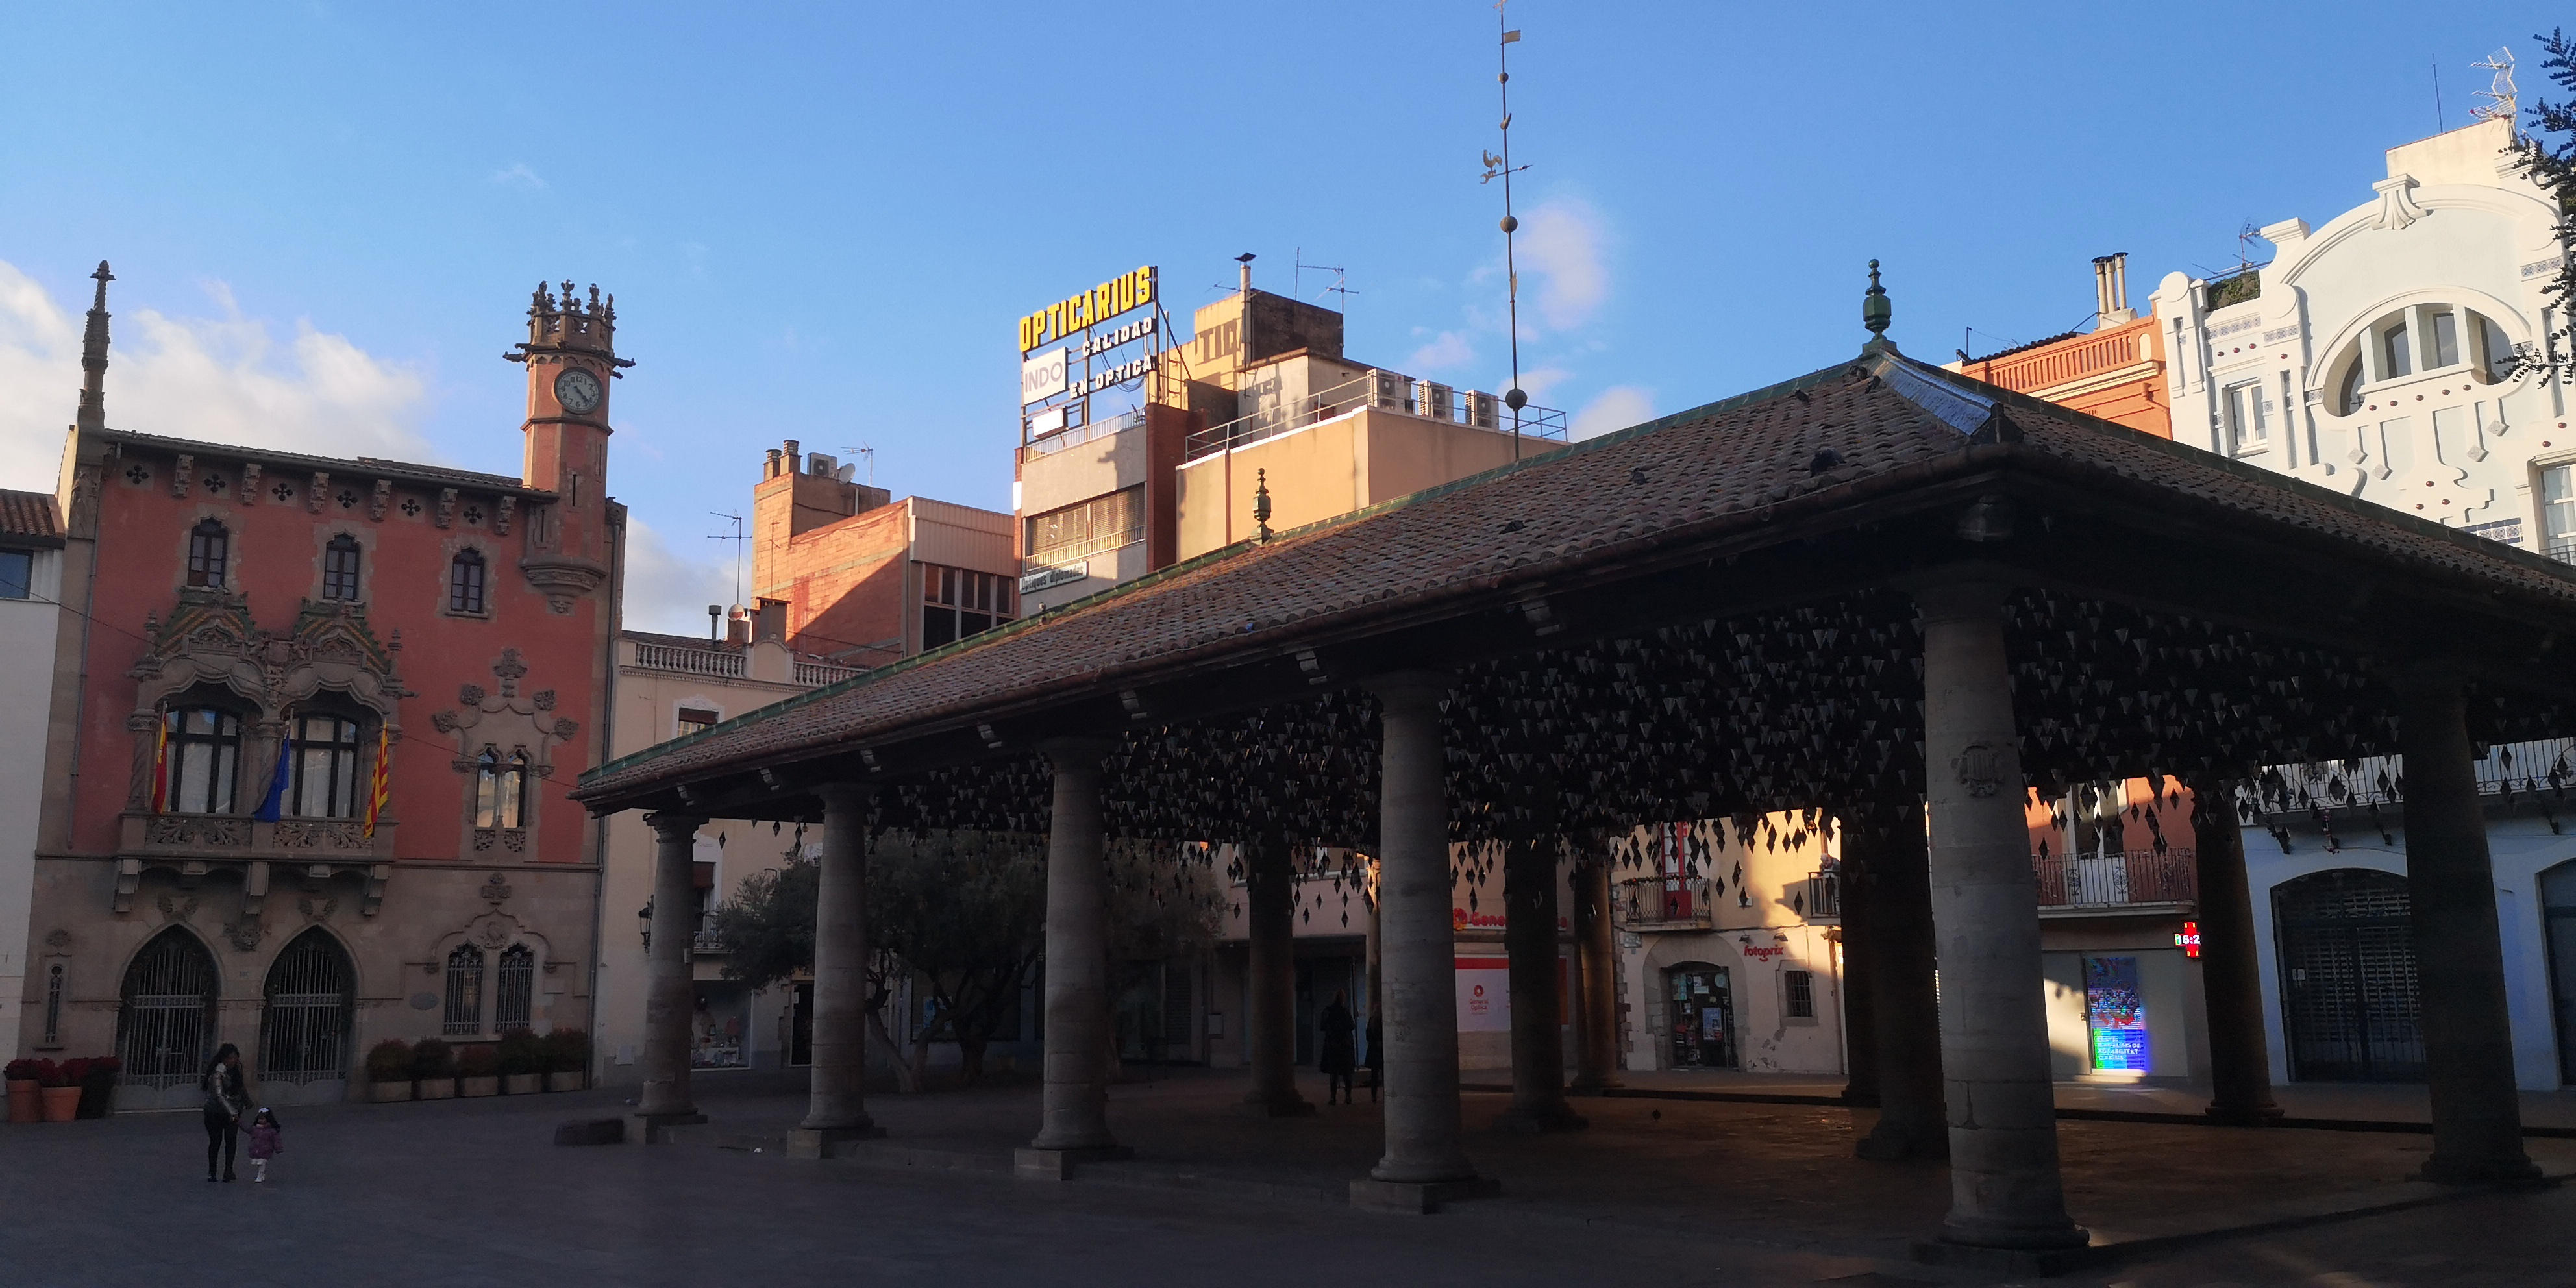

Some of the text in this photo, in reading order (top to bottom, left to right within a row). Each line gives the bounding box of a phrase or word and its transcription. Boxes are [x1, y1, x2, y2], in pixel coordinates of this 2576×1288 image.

[1019, 265, 1152, 352] OPTICARIUS
[1082, 316, 1154, 356] CALIDAD
[1025, 361, 1063, 393] INDO
[1069, 354, 1152, 399] EN OPTICA
[1471, 911, 1509, 927] Gene
[1744, 944, 1784, 958] fotoprix
